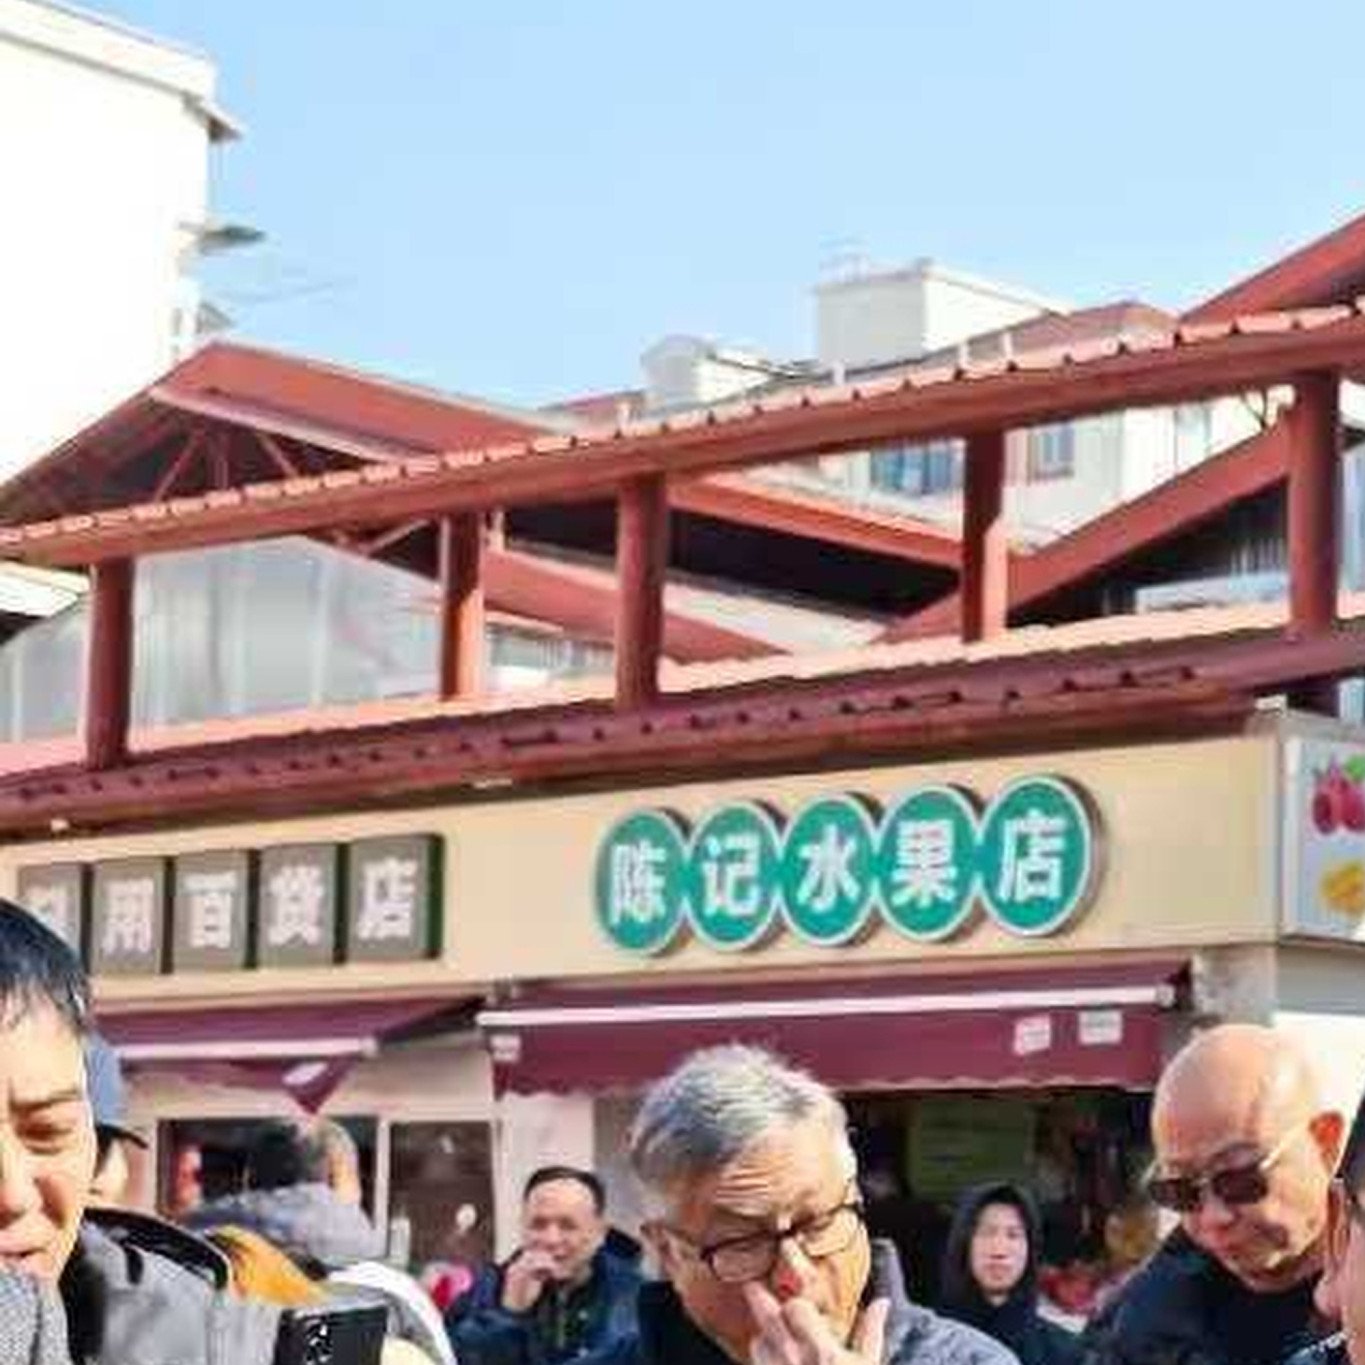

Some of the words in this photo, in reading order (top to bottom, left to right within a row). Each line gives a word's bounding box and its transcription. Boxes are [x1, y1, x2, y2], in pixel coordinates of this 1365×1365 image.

[608, 808, 1069, 925] 陈记水果店
